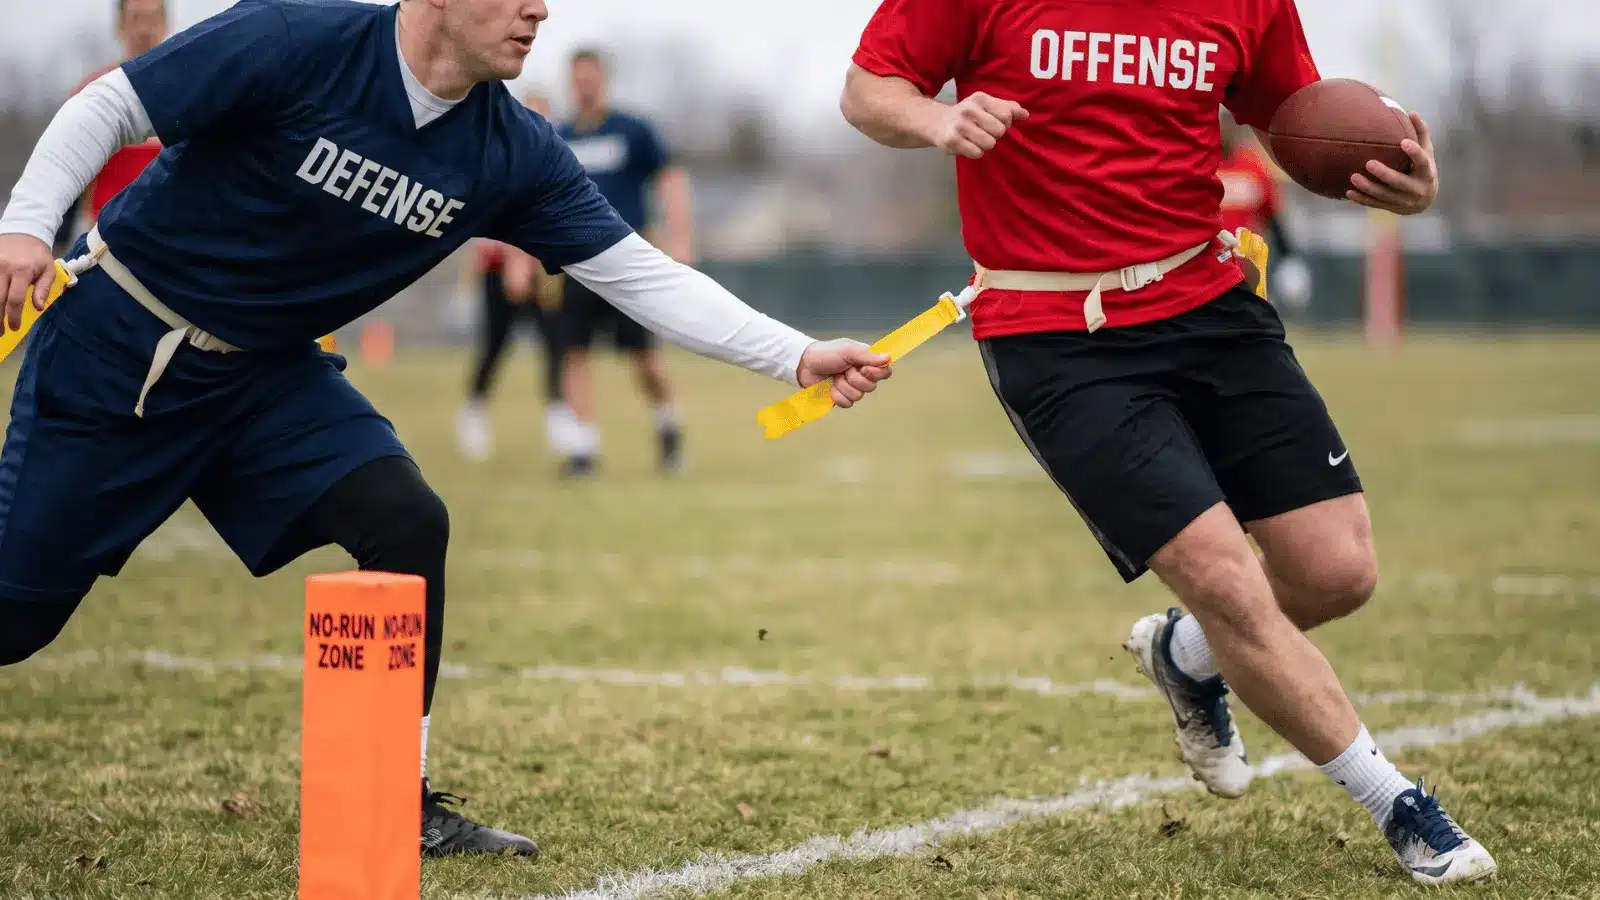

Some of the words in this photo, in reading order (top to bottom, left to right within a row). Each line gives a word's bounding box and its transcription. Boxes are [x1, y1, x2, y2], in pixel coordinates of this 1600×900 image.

[1030, 29, 1218, 92] OFFENSE
[295, 136, 466, 239] DEFENSE
[310, 612, 375, 639] NO-RUN
[384, 612, 422, 639] NO-RUN
[318, 643, 364, 670] ZONE
[387, 643, 416, 671] ZONE
